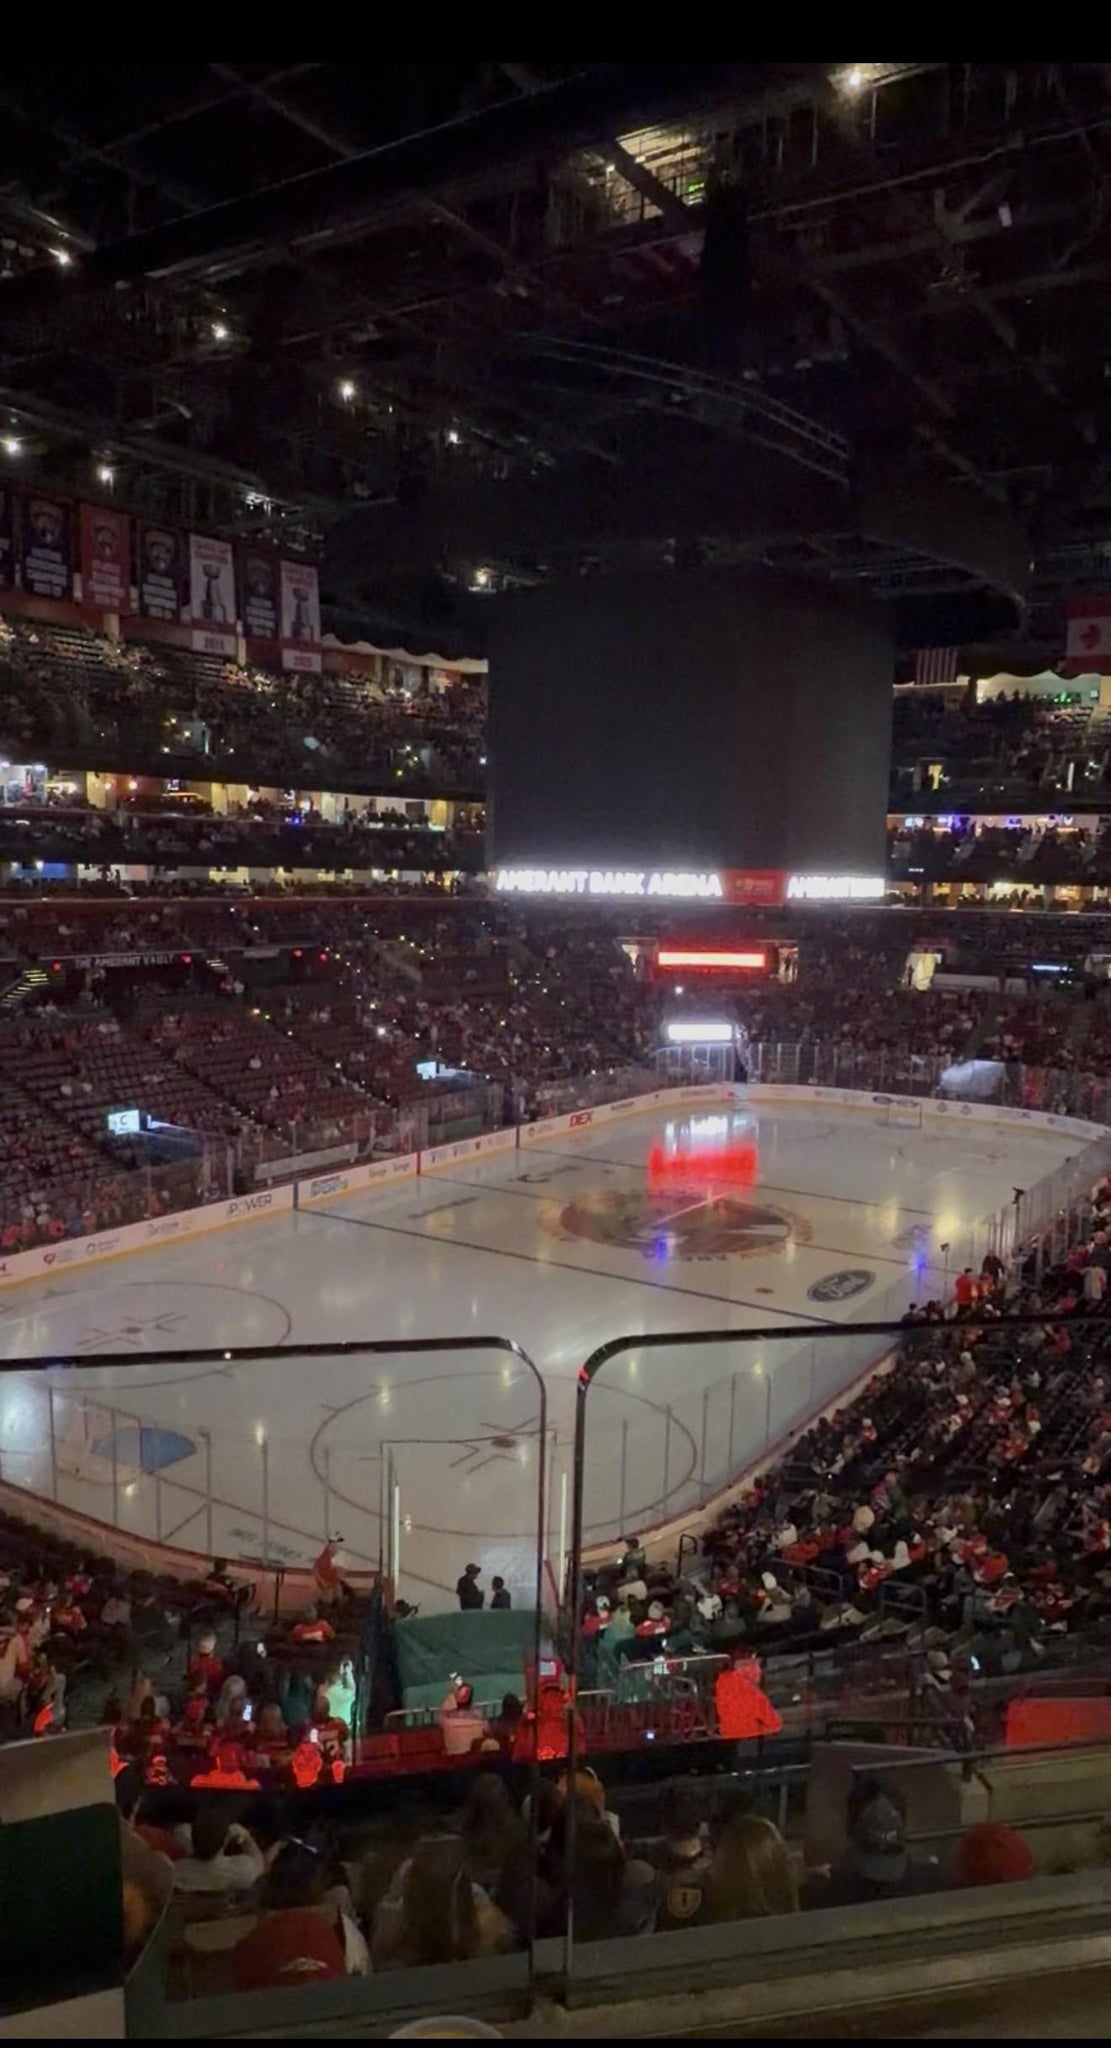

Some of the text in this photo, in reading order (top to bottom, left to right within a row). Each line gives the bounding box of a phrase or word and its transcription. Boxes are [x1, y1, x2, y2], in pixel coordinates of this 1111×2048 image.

[496, 870, 589, 893] AMERANT
[589, 871, 645, 895] BANK
[647, 872, 723, 896] ARENA
[76, 958, 92, 969] THE
[143, 954, 174, 966] VAULT
[227, 1194, 273, 1215] PWER
